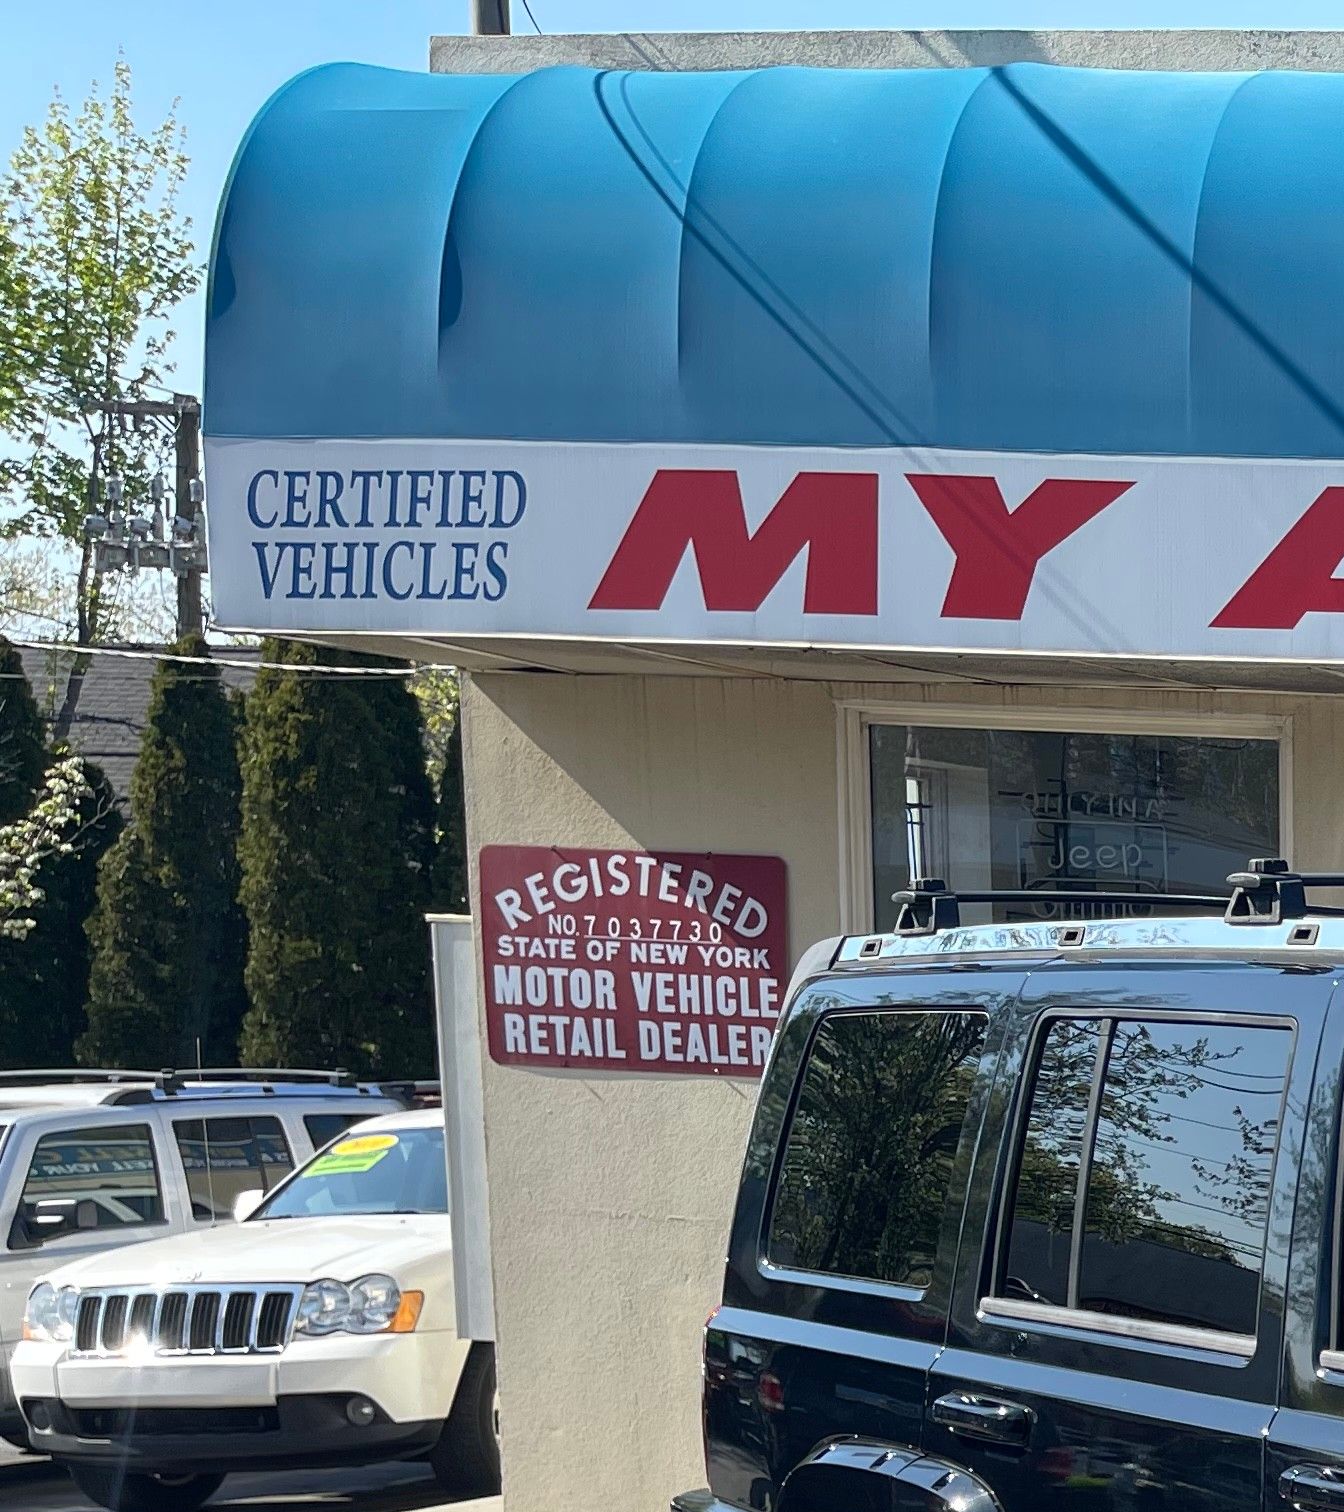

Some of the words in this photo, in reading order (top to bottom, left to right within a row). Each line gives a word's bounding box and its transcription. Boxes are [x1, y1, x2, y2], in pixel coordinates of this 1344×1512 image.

[247, 469, 527, 529] CERTIFIED
[251, 540, 509, 601] VEHICLES
[586, 468, 1138, 620] MY
[1047, 836, 1143, 877] Jeep
[494, 854, 768, 939] REGISTERED
[497, 935, 577, 960] STATE
[586, 939, 621, 962] OF
[630, 942, 688, 965] NEW
[698, 945, 771, 970] YORK
[548, 914, 579, 937] NO.
[583, 915, 723, 944] 7037730
[493, 964, 617, 1011] MOTOR
[631, 970, 779, 1019] VEHICLE
[503, 1012, 627, 1060] RETAIL
[638, 1019, 777, 1066] DEALER
